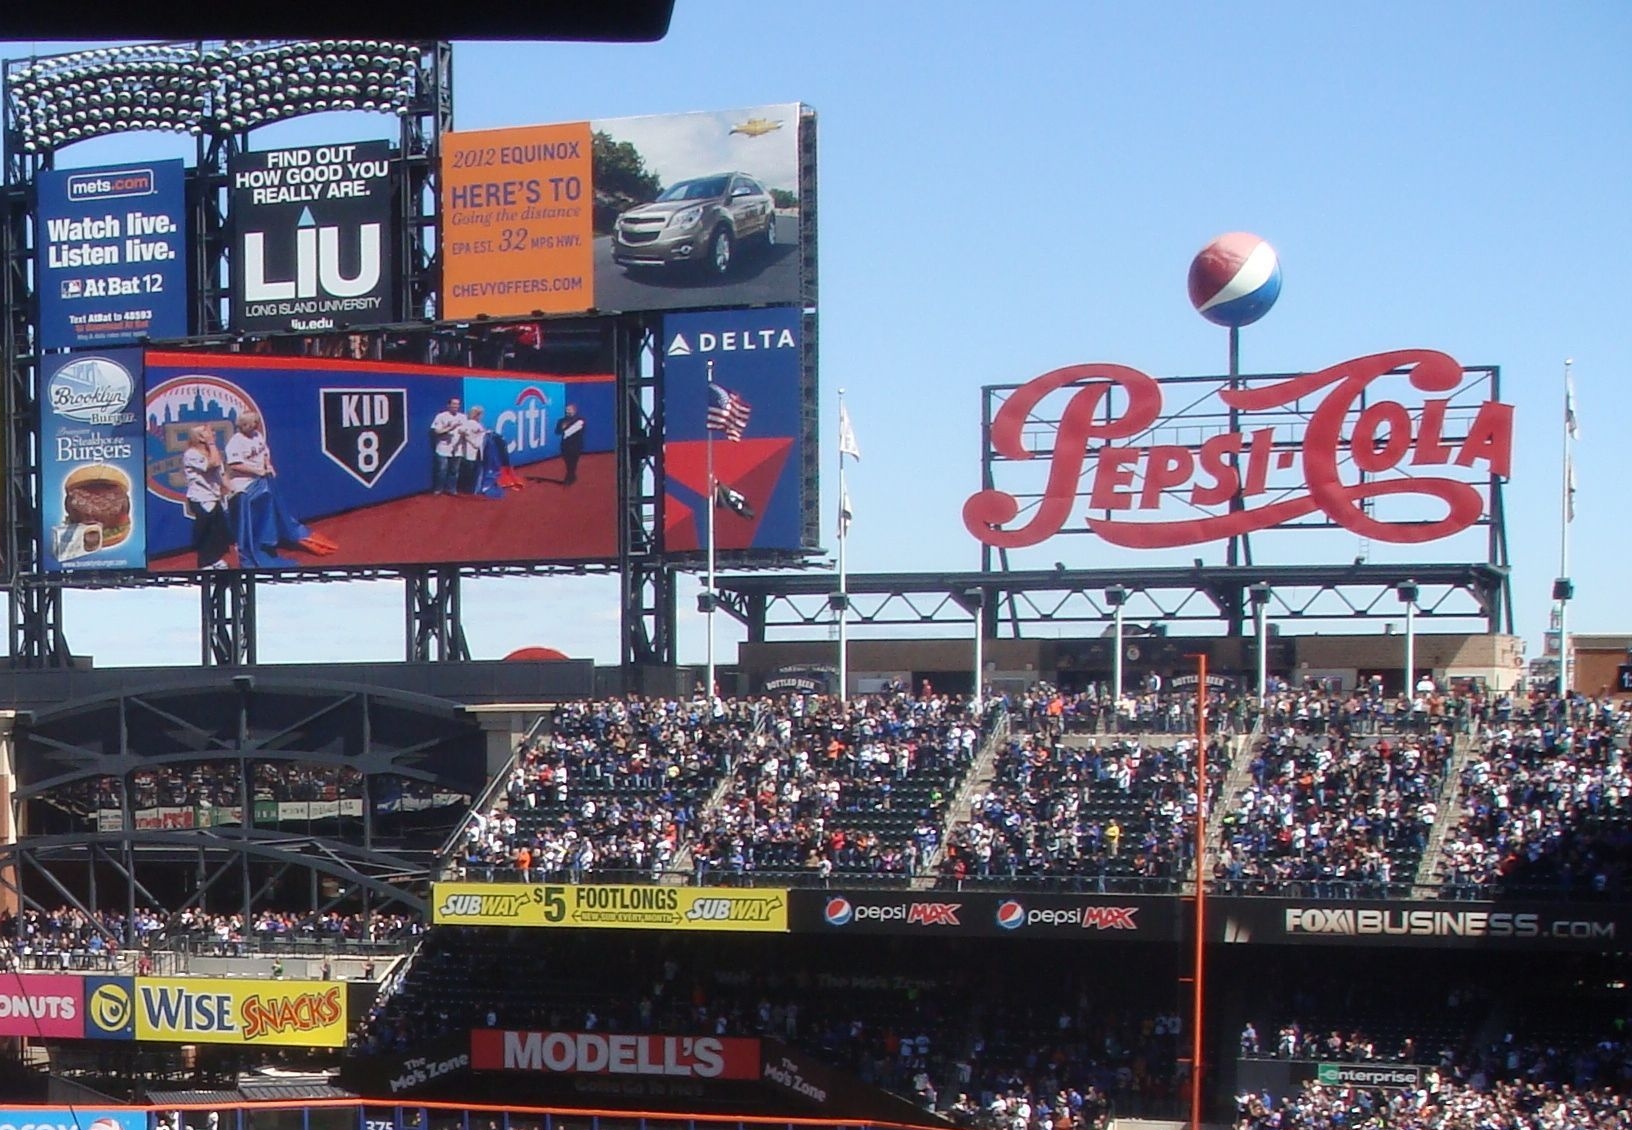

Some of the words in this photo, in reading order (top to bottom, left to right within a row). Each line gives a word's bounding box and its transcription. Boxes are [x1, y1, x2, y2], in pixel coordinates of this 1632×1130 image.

[268, 150, 311, 168] FIND
[316, 146, 356, 165] OUT
[452, 148, 496, 169] 2012
[500, 141, 581, 165] EQUINOX
[73, 176, 149, 194] mets.com
[236, 169, 281, 188] HOW
[286, 165, 343, 184] GOOD
[348, 160, 389, 179] YOU
[253, 185, 323, 205] REALLY
[327, 180, 371, 199] ARE.
[451, 179, 541, 209] HERE'S
[549, 176, 582, 202] TO
[47, 215, 120, 242] Watch
[127, 212, 177, 236] live.
[452, 211, 493, 227] Going
[496, 208, 518, 222] the
[521, 205, 582, 221] distance
[48, 243, 119, 268] Listen
[126, 239, 175, 263] live.
[452, 242, 471, 255] EPA
[499, 227, 529, 251] 32
[531, 236, 554, 249] MPG
[83, 279, 106, 298] At
[108, 276, 140, 296] Bat
[143, 273, 163, 292] 12
[452, 276, 582, 298] CHEVYOFFERS.COM
[245, 304, 277, 317] LONG
[279, 301, 317, 315] ISLAND
[319, 297, 382, 313] UNIVERSITY
[700, 329, 795, 353] DELTA
[54, 385, 126, 412] Brooklyn
[342, 394, 389, 428] KID
[496, 405, 547, 454] citi
[56, 437, 132, 463] Burgers
[357, 432, 379, 473] 8
[440, 893, 531, 917] SUBWAY
[533, 886, 567, 922] $5
[575, 887, 679, 910] FOOTLONGS
[686, 895, 783, 922] SUBWAY
[854, 904, 906, 922] pepsi
[907, 903, 962, 925] MAX
[1027, 907, 1081, 926] pepsi
[1082, 906, 1139, 930] MAX
[141, 986, 236, 1032] WISE
[241, 985, 342, 1041] SNACKS
[404, 1057, 426, 1071] The
[504, 1031, 725, 1078] MODELL'S
[390, 1069, 426, 1092] Mo's
[426, 1054, 469, 1078] Zone
[764, 1062, 792, 1086] Mo's
[792, 1075, 826, 1102] Zone
[1324, 1068, 1418, 1085] enterprise
